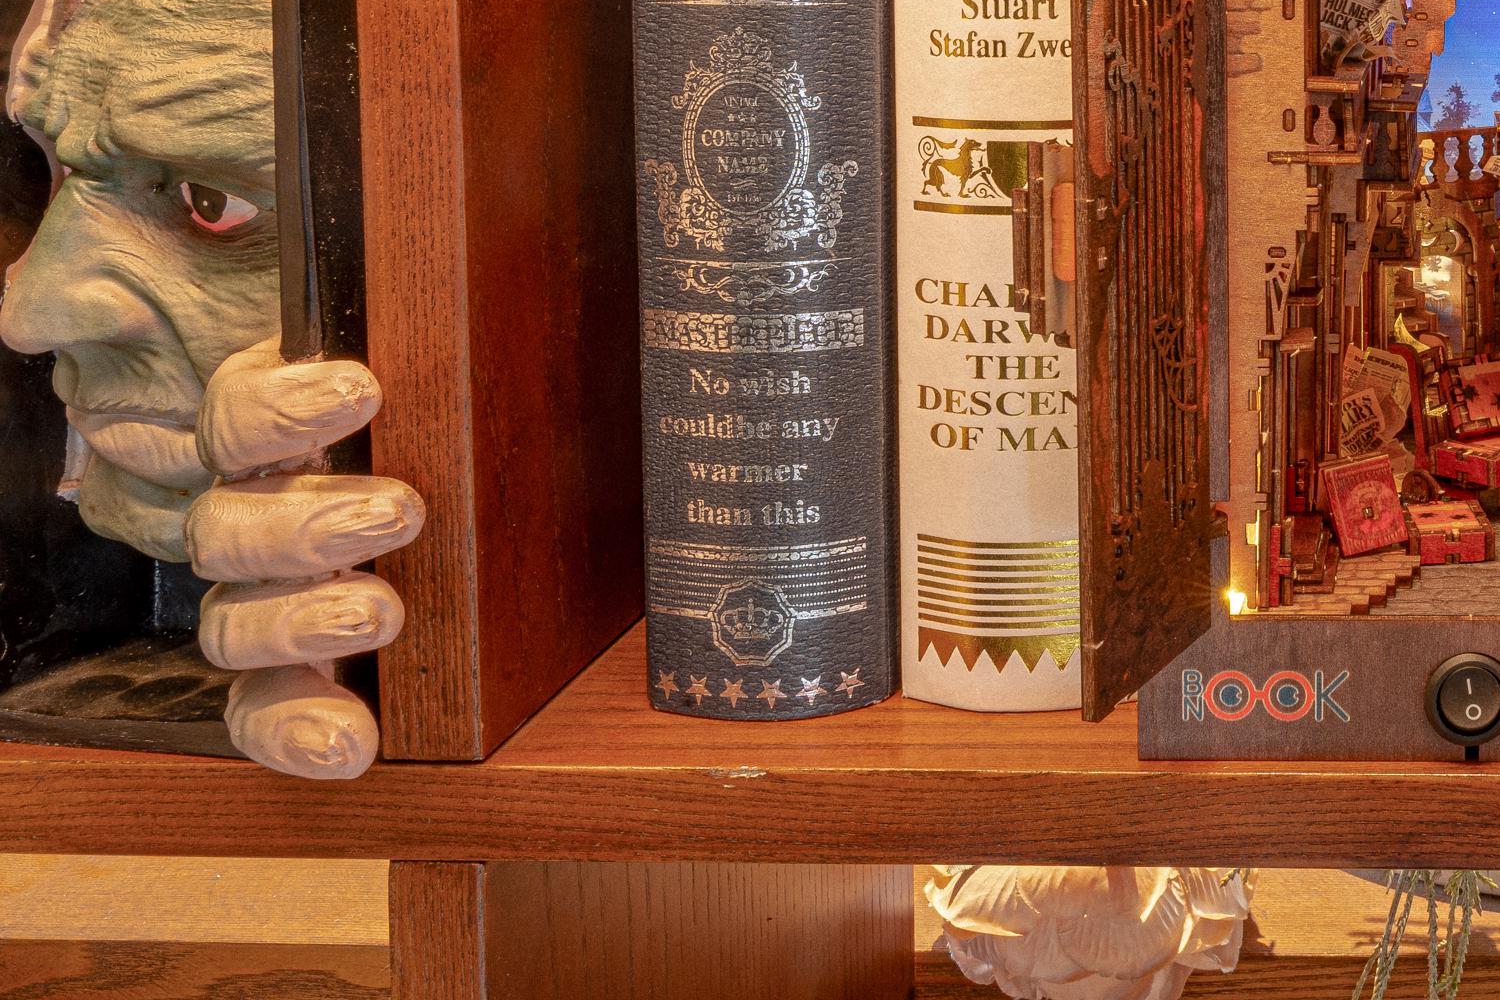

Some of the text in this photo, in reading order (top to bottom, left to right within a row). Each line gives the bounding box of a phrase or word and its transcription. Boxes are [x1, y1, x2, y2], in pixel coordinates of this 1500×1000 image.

[930, 29, 1008, 58] Stafan
[701, 128, 786, 148] COMPANY
[717, 156, 769, 174] NAME
[966, 354, 1061, 380] THE
[689, 369, 812, 397] No wish
[781, 417, 840, 442] any
[930, 423, 1078, 452] OF MA
[686, 462, 809, 483] warmer
[687, 499, 822, 527] than this
